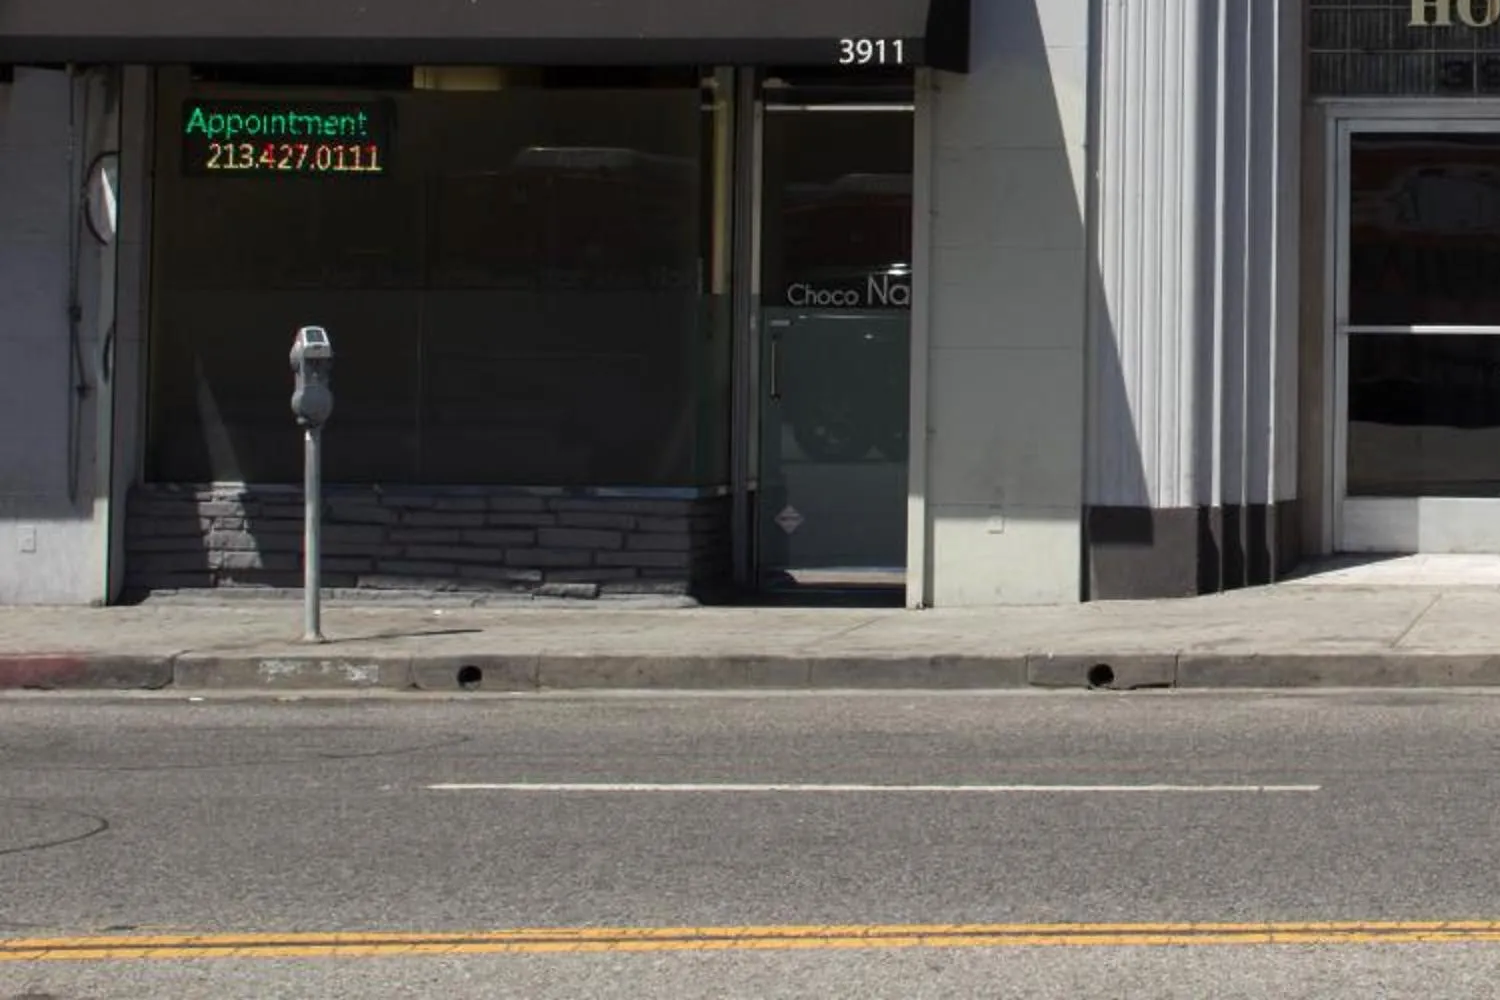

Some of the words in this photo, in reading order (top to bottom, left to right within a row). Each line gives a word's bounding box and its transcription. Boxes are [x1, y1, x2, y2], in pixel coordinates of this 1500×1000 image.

[838, 38, 905, 65] 3911
[185, 106, 368, 140] Appointment
[206, 142, 384, 172] 213.427.0111
[787, 283, 859, 306] Choco
